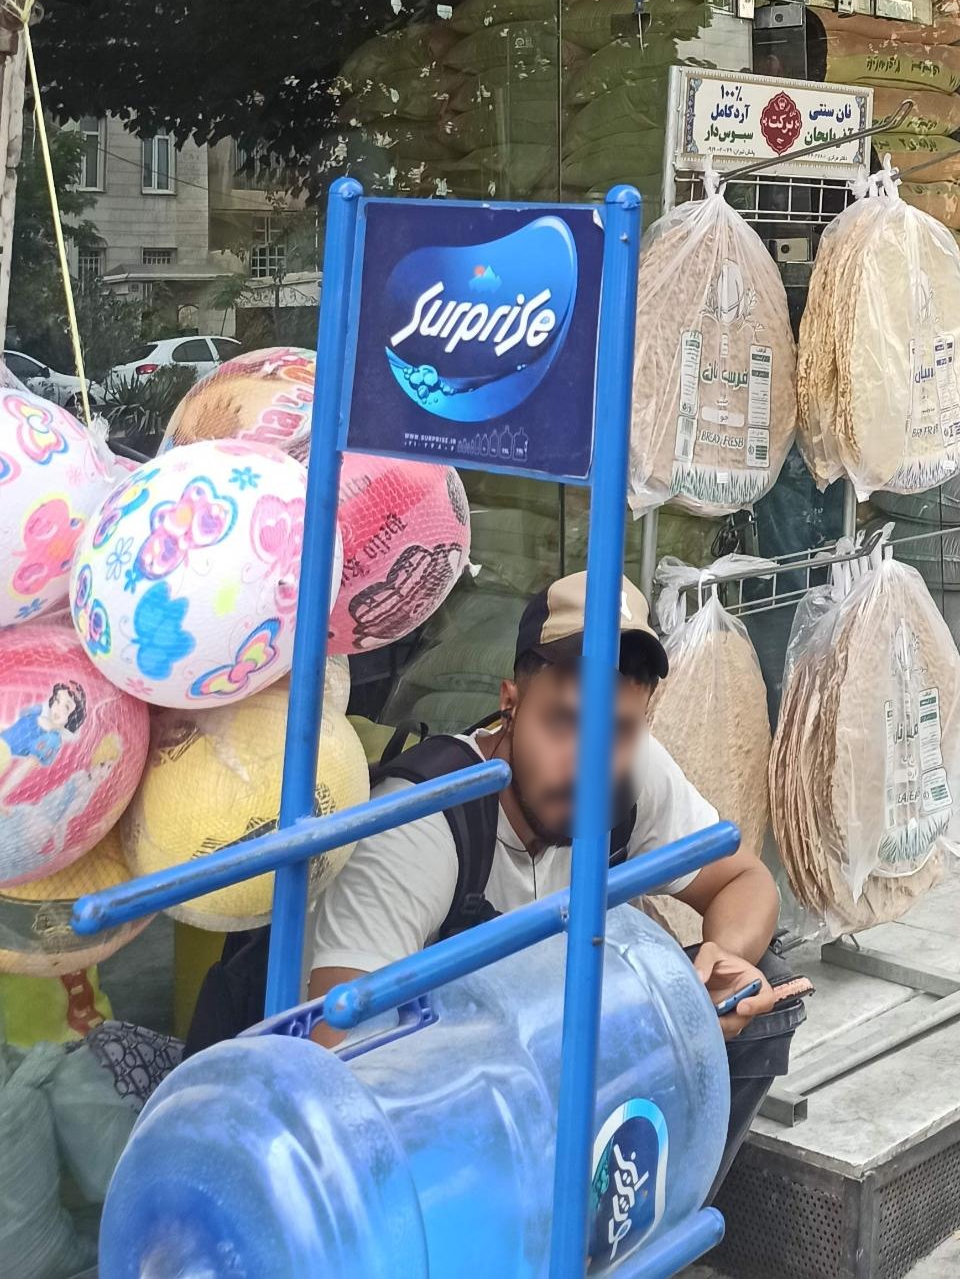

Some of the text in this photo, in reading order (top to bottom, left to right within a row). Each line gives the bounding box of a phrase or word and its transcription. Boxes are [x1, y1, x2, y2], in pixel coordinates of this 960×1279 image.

[710, 102, 751, 124] آرد کامل
[808, 103, 852, 123] نان سنتی
[390, 281, 556, 357] Surprise
